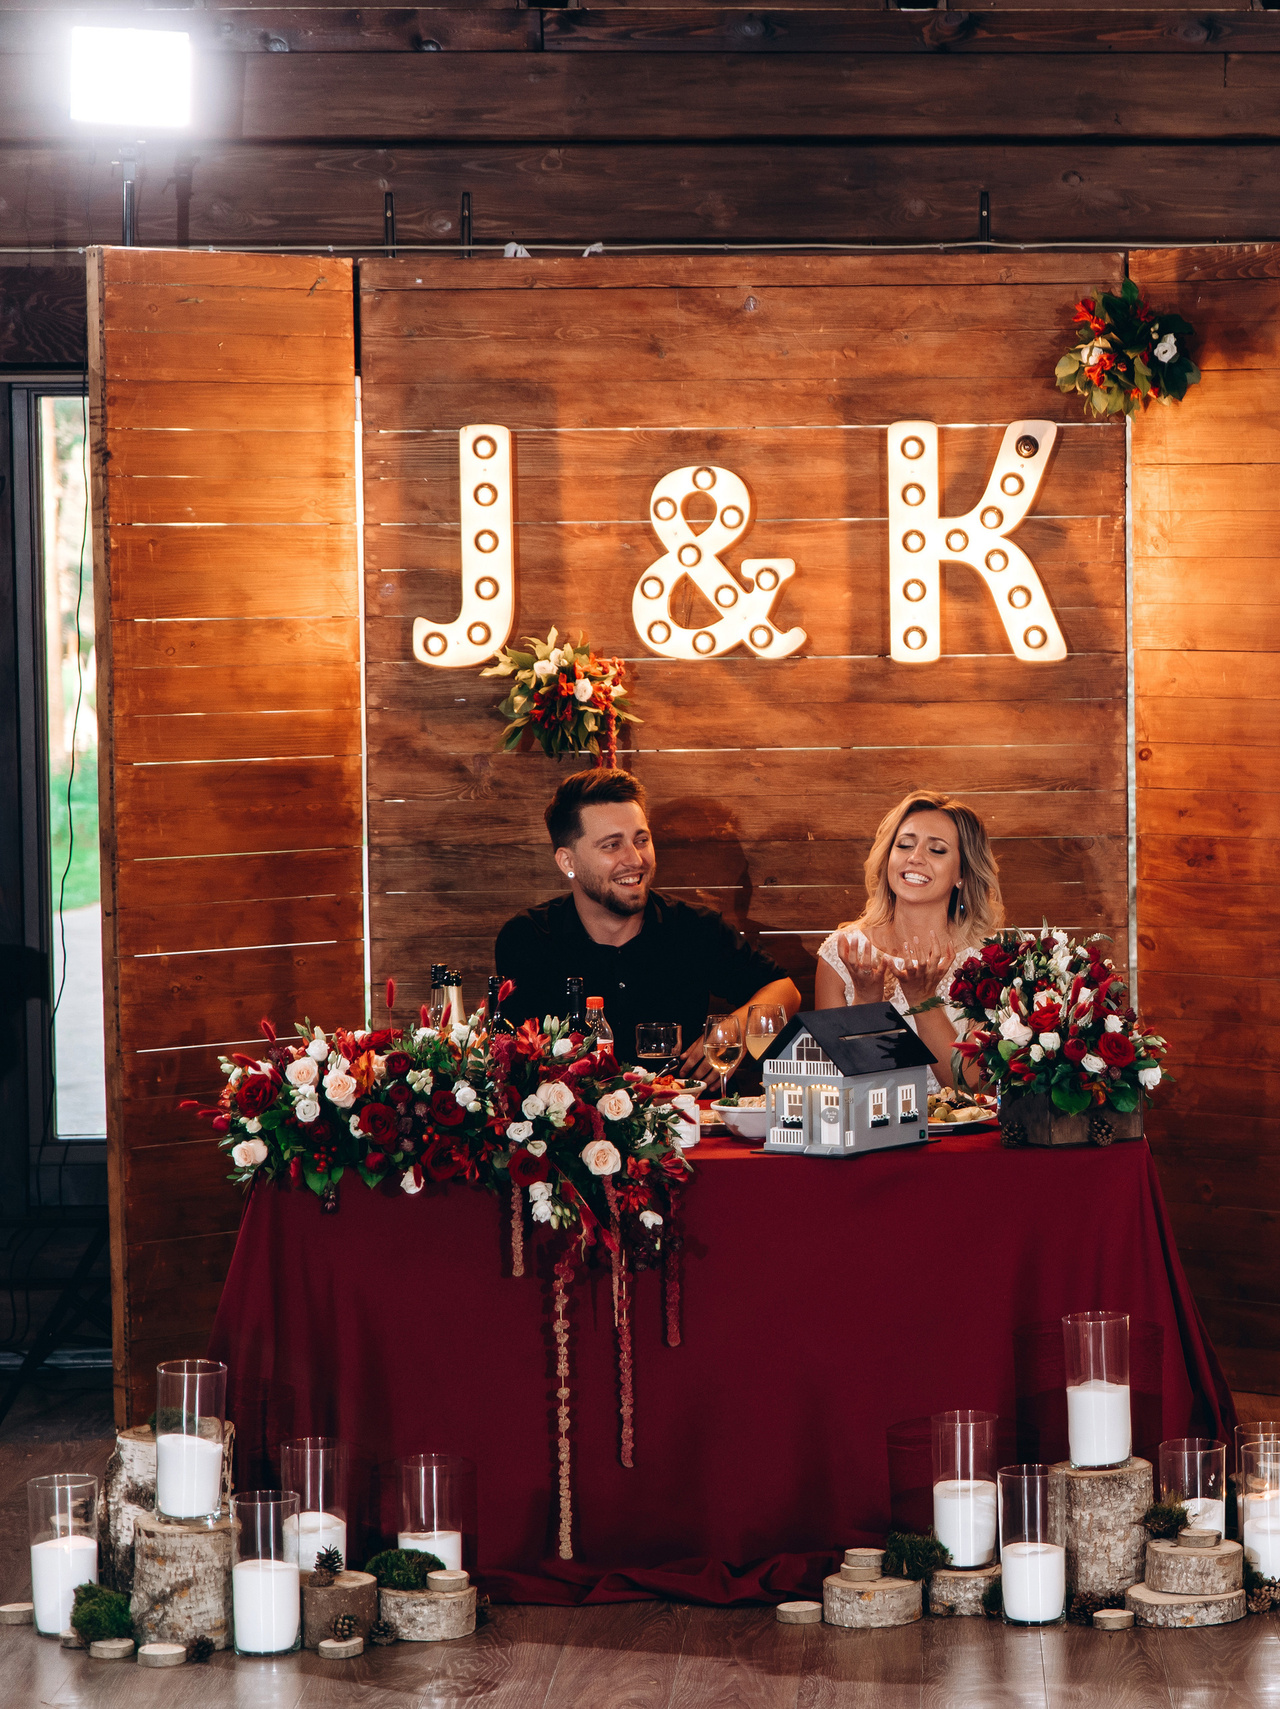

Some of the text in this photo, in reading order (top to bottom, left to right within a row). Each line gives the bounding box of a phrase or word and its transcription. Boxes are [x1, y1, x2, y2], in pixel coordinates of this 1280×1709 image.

[412, 420, 1068, 668] J & K
